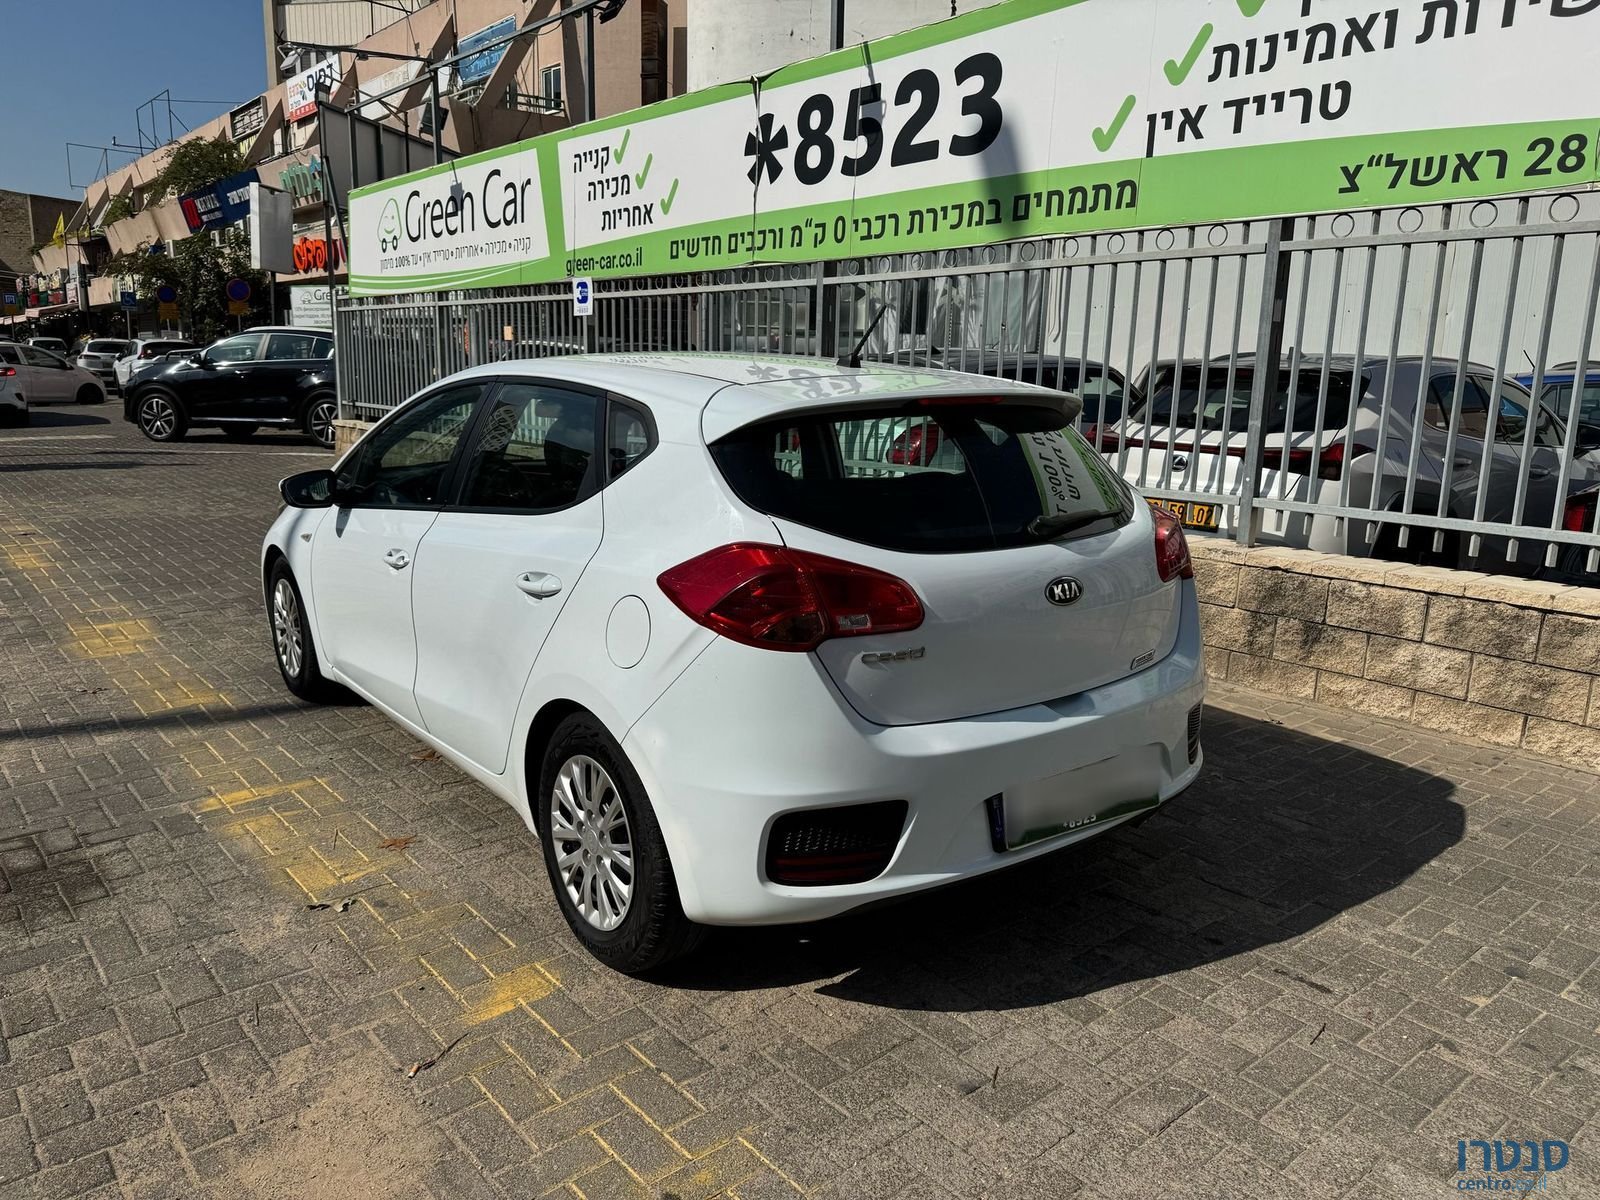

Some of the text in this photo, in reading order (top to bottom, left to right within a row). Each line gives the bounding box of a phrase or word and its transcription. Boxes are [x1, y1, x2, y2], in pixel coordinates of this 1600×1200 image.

[1207, 8, 1399, 83] ואמינות
[1145, 80, 1352, 158] טרייד אין
[573, 146, 610, 174] קנייה
[1338, 133, 1588, 194] 28 ראשל"צ
[588, 174, 630, 202] מכירה
[1011, 178, 1138, 223] מתמחים
[405, 169, 532, 243] Green Car
[601, 203, 654, 232] אחריות
[907, 198, 1003, 236] במכירת
[727, 224, 784, 254] ורכבים
[833, 215, 846, 243] 0
[852, 212, 900, 241] רכבי
[485, 240, 507, 255] מכירה
[513, 237, 531, 254] קניה
[669, 235, 722, 260] חדשים
[566, 247, 643, 276] green-car.co.il
[1053, 582, 1081, 600] KIA
